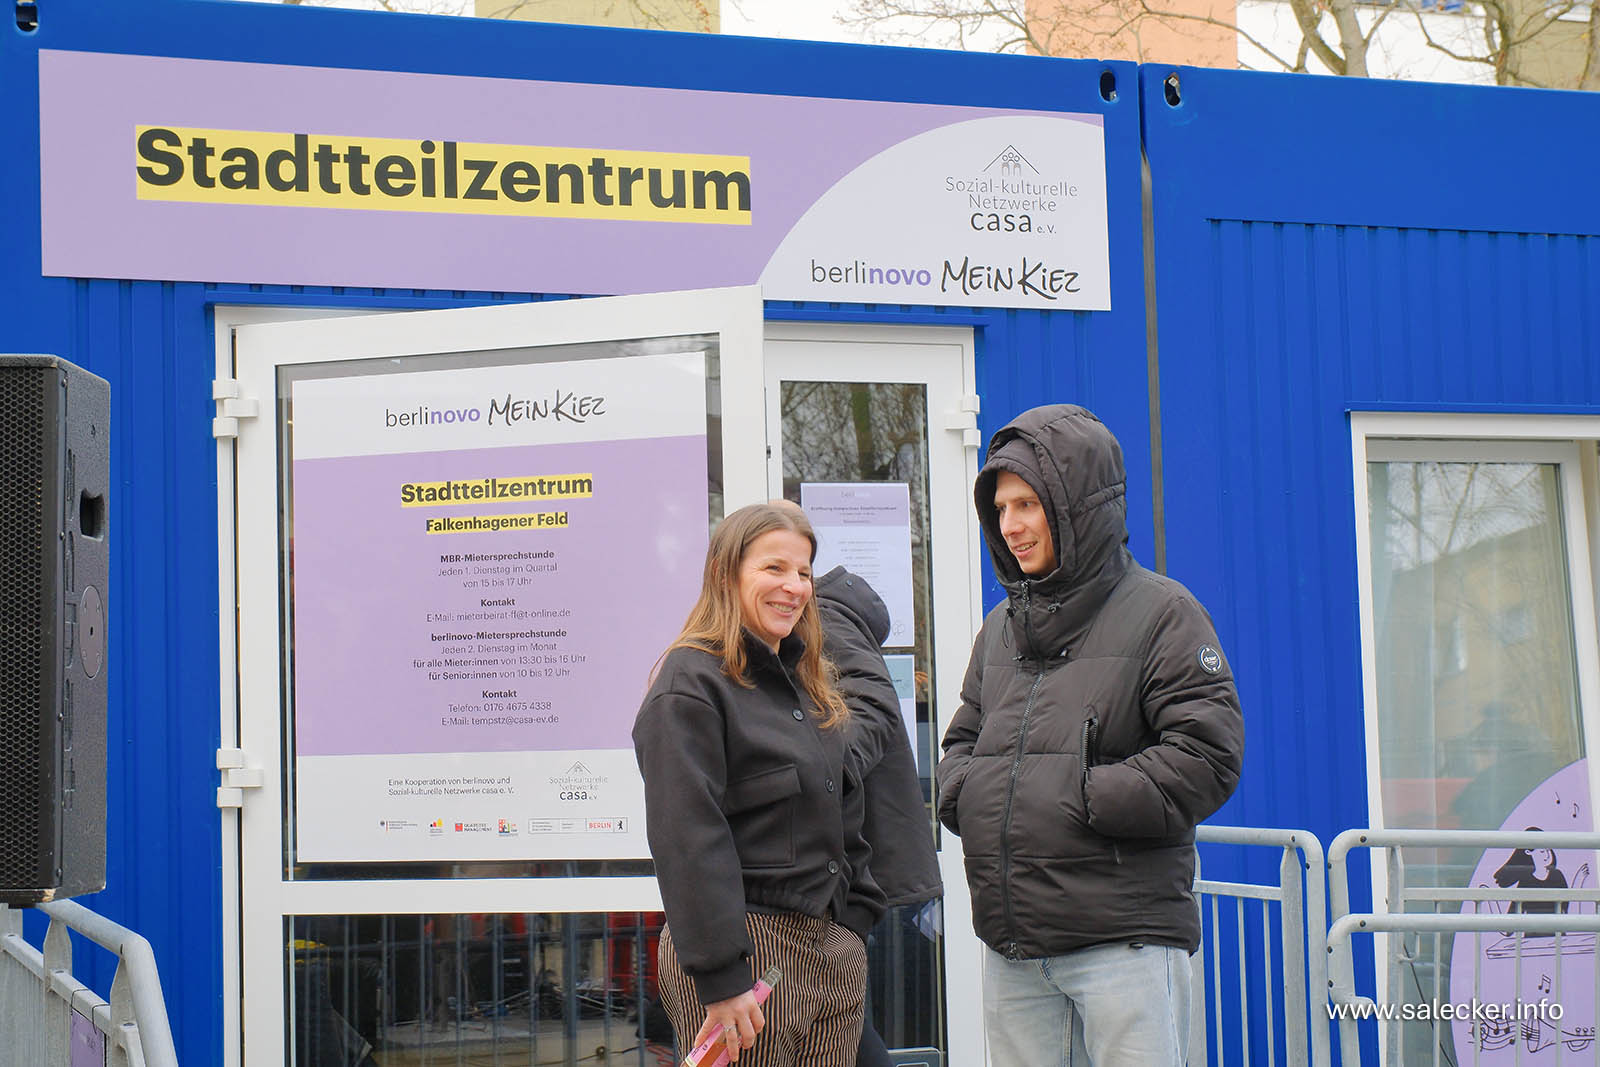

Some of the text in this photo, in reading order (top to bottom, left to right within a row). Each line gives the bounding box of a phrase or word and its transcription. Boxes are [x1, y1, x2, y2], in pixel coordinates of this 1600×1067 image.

[135, 127, 752, 212] Stadtteilzentrum
[944, 176, 1078, 197] Sozial-kulturelle
[968, 194, 1058, 212] Netzwerke
[970, 212, 1032, 233] casa
[810, 258, 932, 287] berlinovo
[385, 406, 481, 428] berlinovo
[400, 477, 593, 504] Stadtteilzentrum
[425, 511, 569, 533] Falkenhagener Feld
[440, 550, 555, 564] MBR-Mietersprechstunde
[438, 567, 464, 577] Jeden
[473, 565, 511, 576] Dienstag
[512, 564, 524, 574] im
[525, 562, 558, 573] Quartal
[462, 576, 533, 589] von 15 bis 17 Uhr
[480, 597, 516, 607] Kontakt
[426, 612, 455, 623] E-Mail:
[431, 629, 568, 642] berlinovo-Mietersprechstunde
[441, 642, 558, 655] Jeden 2. Dienstag im Monat
[413, 653, 587, 669] für alle Mieter:innen von 13:30 bis 16 Uhr
[428, 667, 571, 680] für Senior:innen von 10 bis 12 Uhr
[482, 689, 518, 699] Kontakt
[448, 701, 552, 713] Telefon: 0176 4675 4338
[441, 716, 470, 726] E-Mail:
[388, 778, 403, 786] Eine
[404, 776, 447, 787] Kooperation
[462, 776, 496, 785] berlinovo
[497, 776, 511, 785] und
[388, 786, 443, 796] Sozial-kulturelle
[444, 786, 481, 795] Netzwerke
[482, 787, 498, 795] casa
[559, 790, 587, 801] casa
[589, 821, 612, 830] BERLIN
